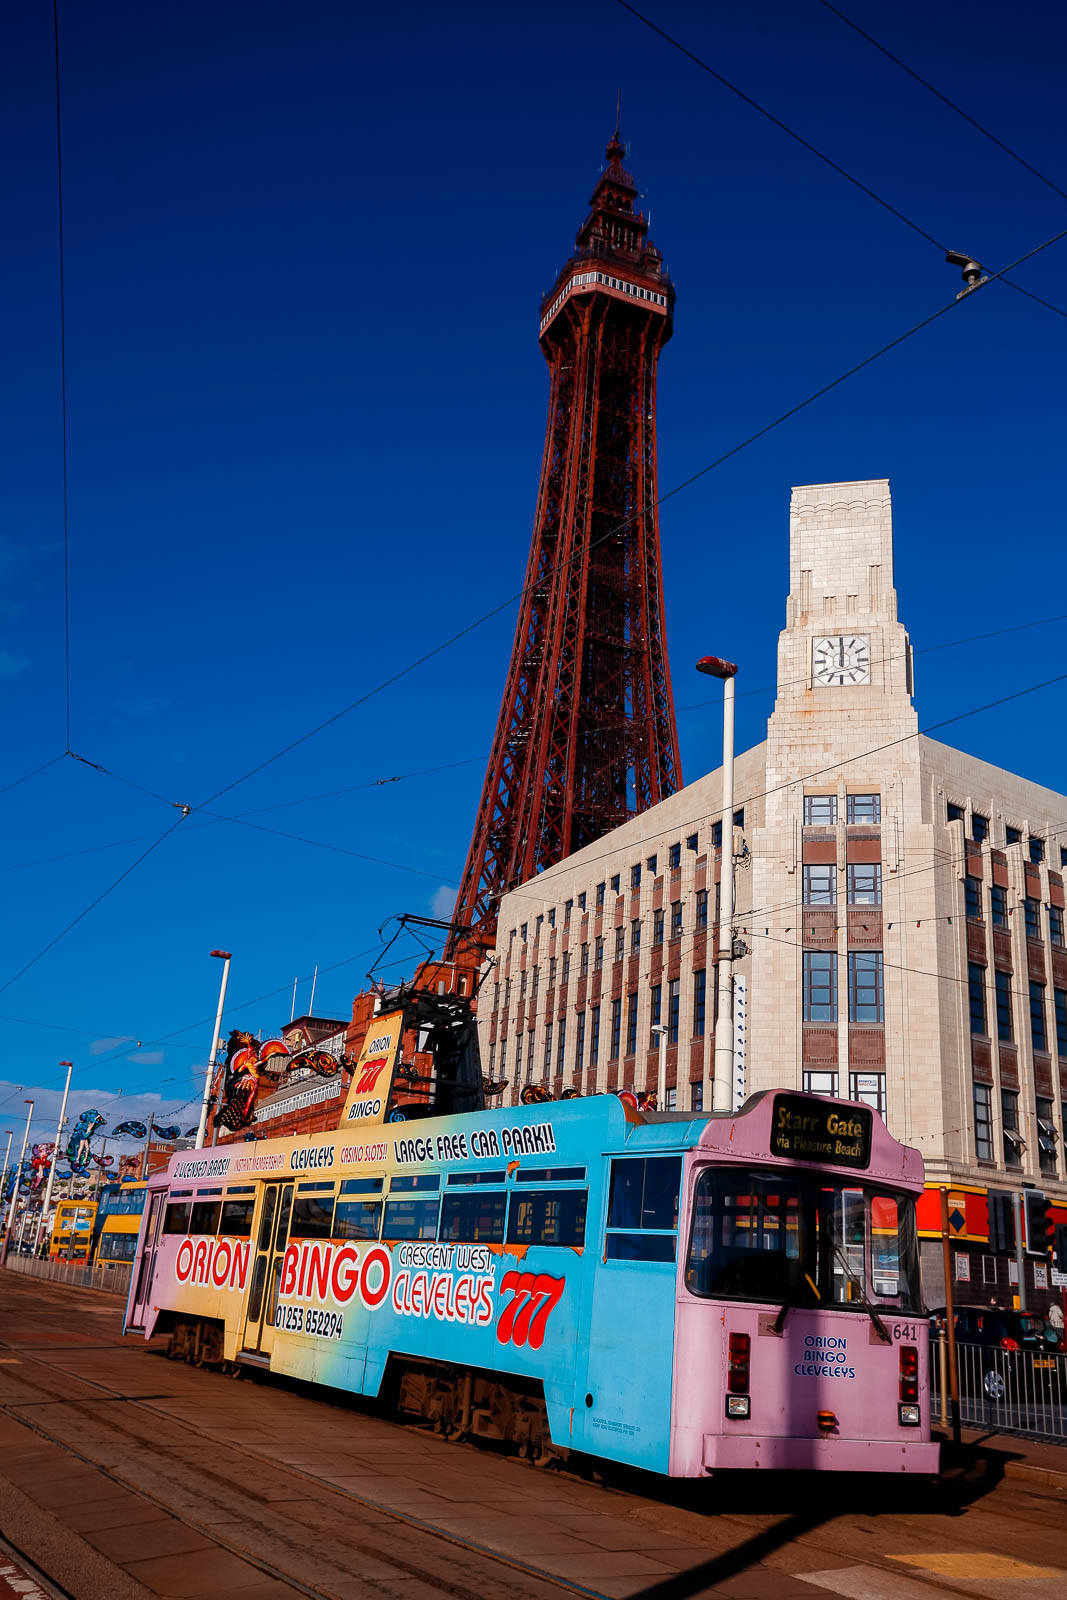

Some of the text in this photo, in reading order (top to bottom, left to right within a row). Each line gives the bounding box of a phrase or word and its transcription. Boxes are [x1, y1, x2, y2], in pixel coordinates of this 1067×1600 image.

[368, 1036, 391, 1054] ORION
[356, 1057, 389, 1094] 777
[348, 1100, 381, 1119] BINGO
[777, 1107, 863, 1137] Starr Gate
[340, 1143, 388, 1163] CASINO SLOTS!!
[393, 1123, 556, 1164] LARGE FREE CAR PARK!!
[776, 1133, 861, 1157] via Pleasure Beach
[179, 1159, 208, 1178] LICENSED
[290, 1145, 335, 1170] CLEVELEYS
[175, 1239, 251, 1291] ORION
[399, 1245, 496, 1275] CRESCENT WEST,
[278, 1243, 391, 1307] BINGO
[392, 1272, 494, 1323] CLEVELEYS
[275, 1306, 343, 1339] 01253 852294
[496, 1271, 566, 1350] 777
[804, 1335, 847, 1350] ORION
[893, 1324, 918, 1341] 641
[804, 1350, 847, 1364] BINGO
[794, 1364, 856, 1379] CLEVELEYS
